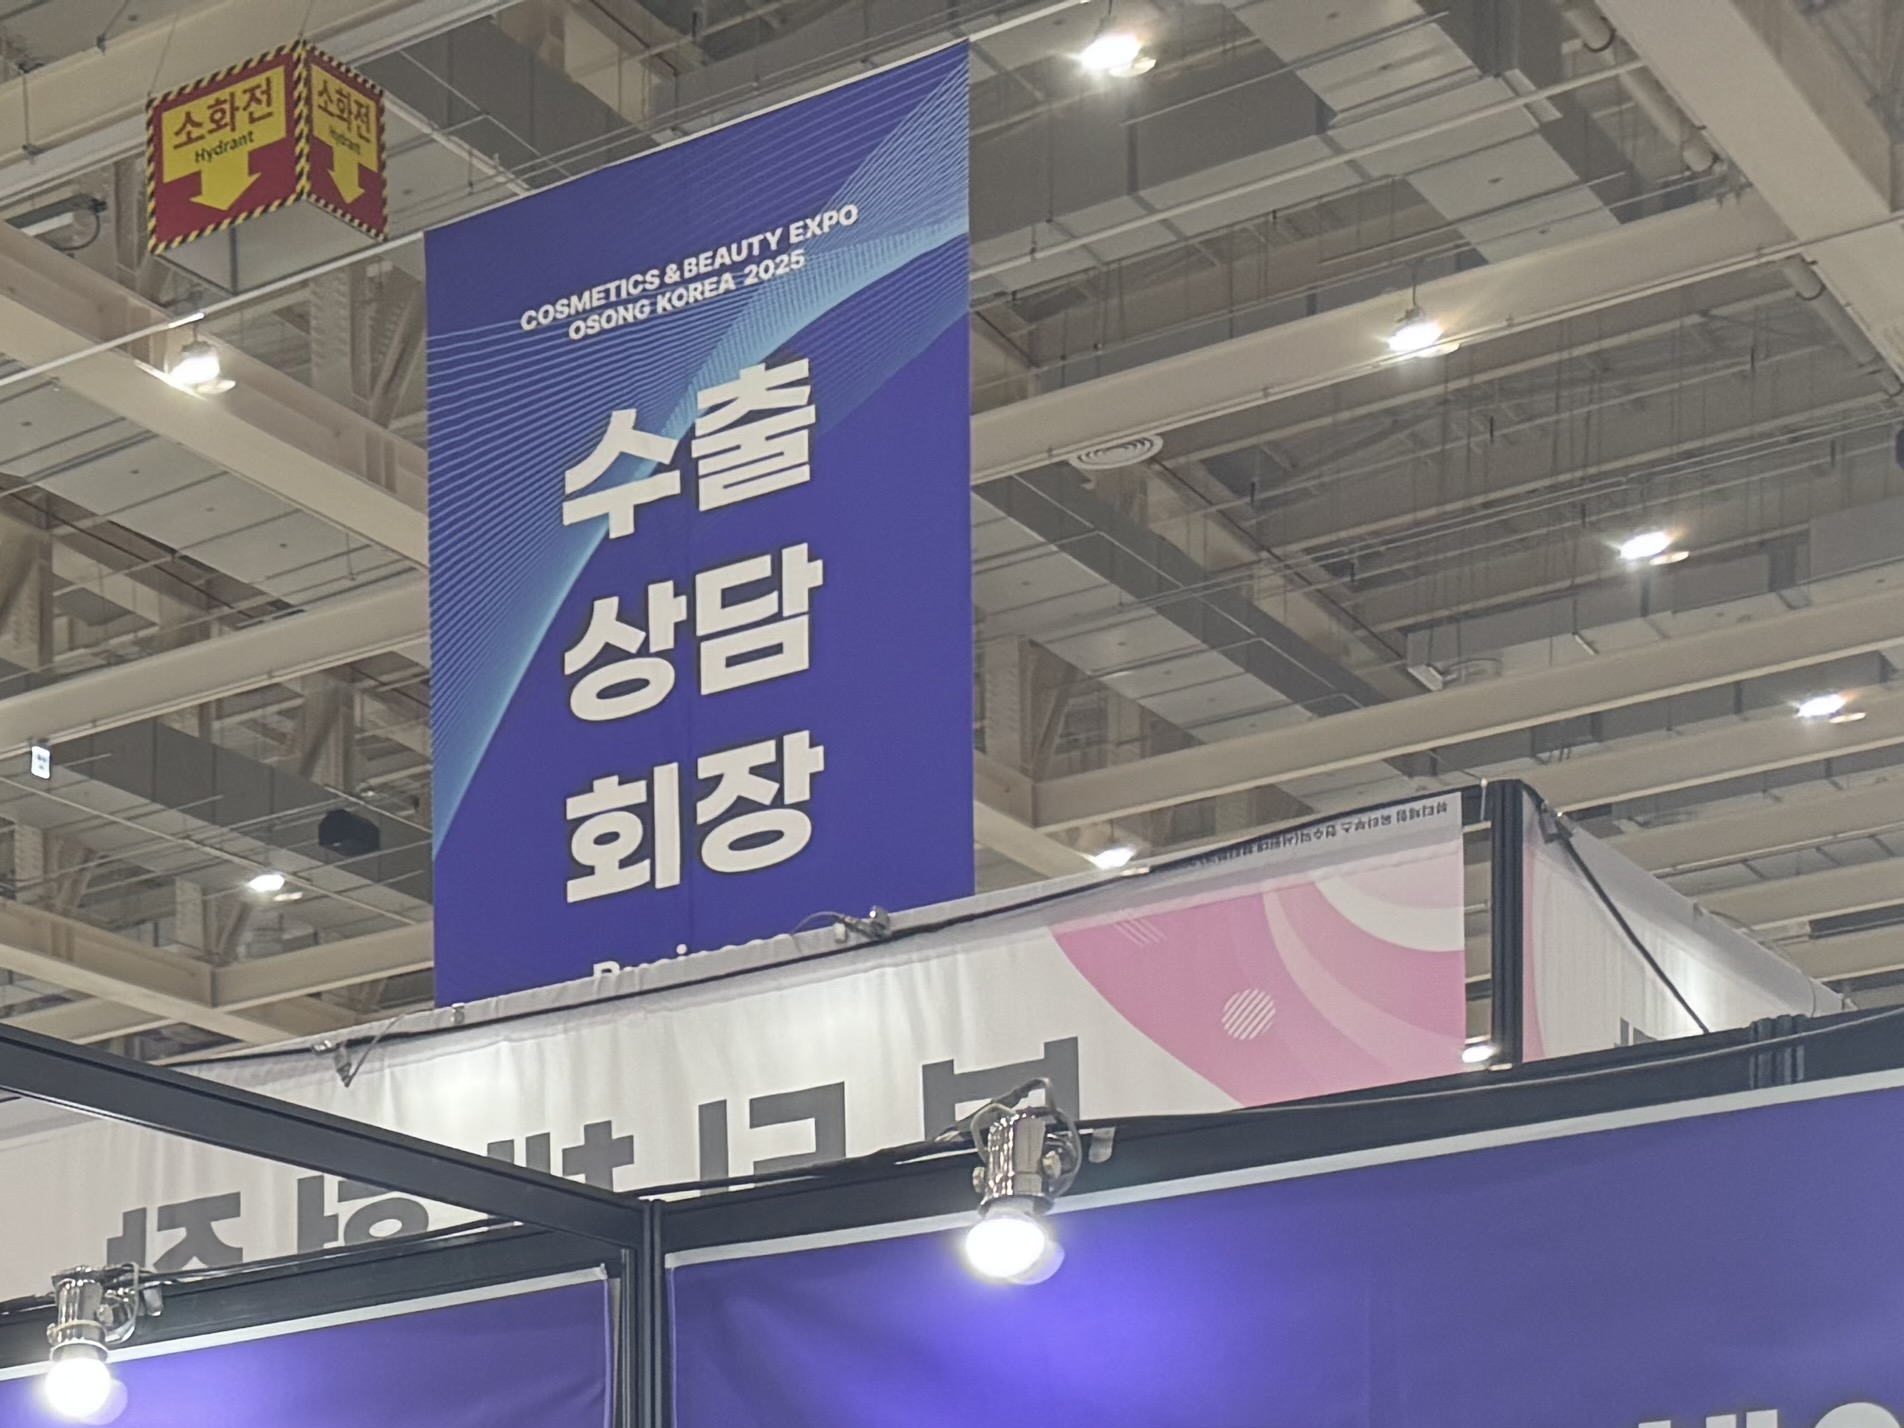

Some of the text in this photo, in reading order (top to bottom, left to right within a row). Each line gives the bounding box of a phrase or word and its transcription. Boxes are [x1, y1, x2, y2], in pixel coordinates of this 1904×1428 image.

[172, 76, 274, 151] 소화전
[194, 131, 255, 163] Hydrant
[317, 79, 372, 143] 소화전
[519, 203, 859, 332] COSMETICS & BEAUTY EXPO
[568, 250, 807, 341] OSONG KOREA 2025
[562, 357, 817, 539] 수출
[564, 541, 822, 722] 상담
[565, 728, 824, 904] 회장
